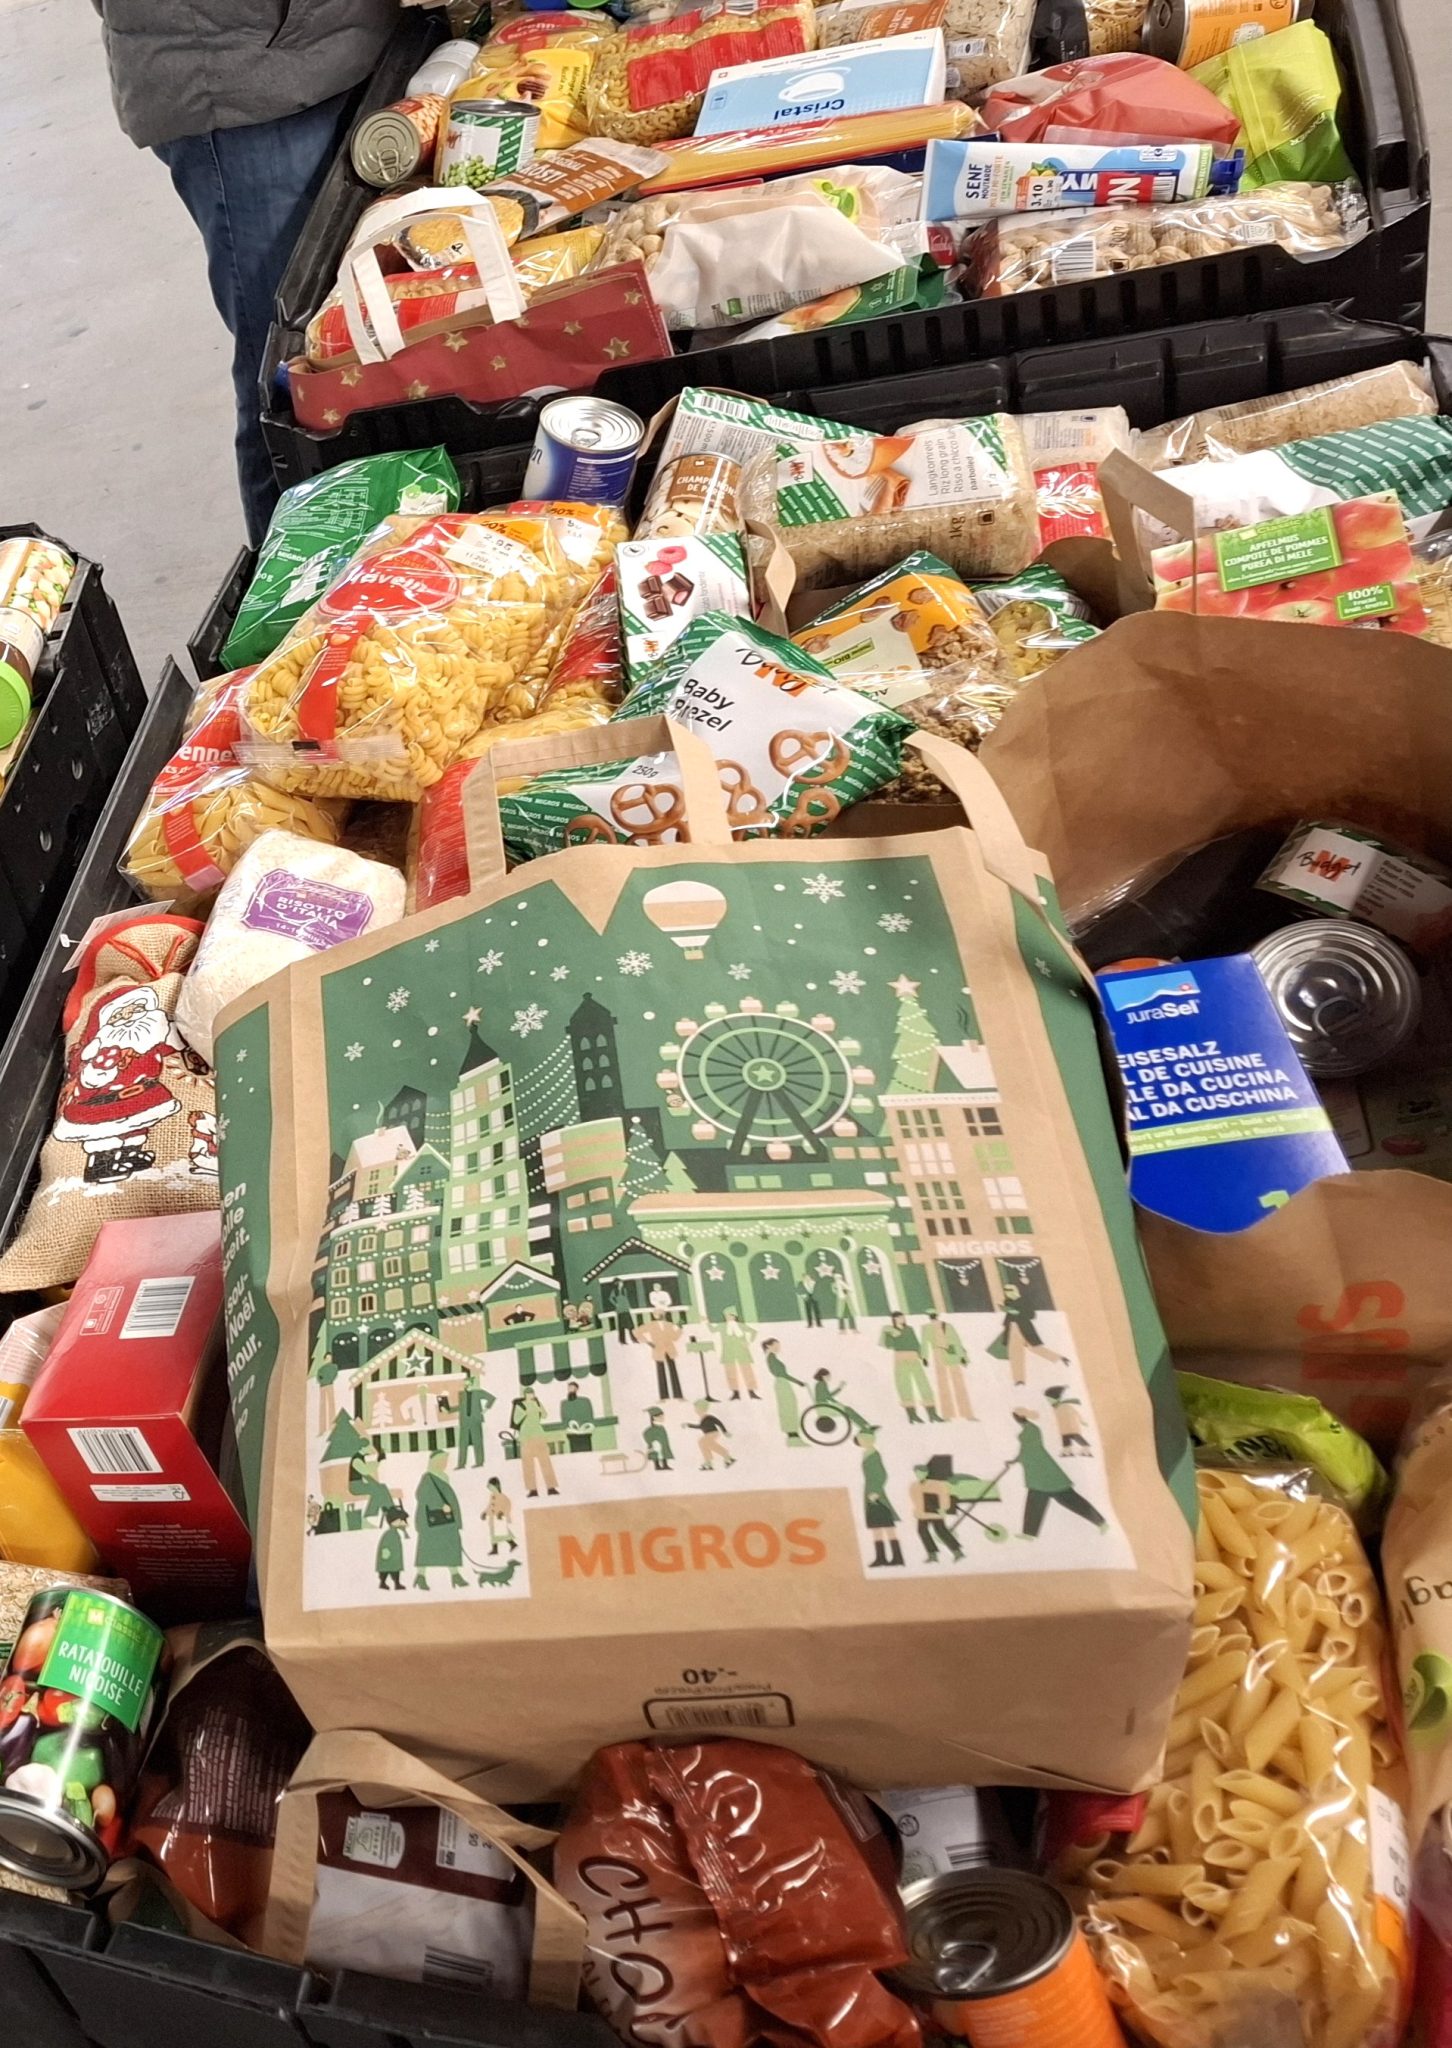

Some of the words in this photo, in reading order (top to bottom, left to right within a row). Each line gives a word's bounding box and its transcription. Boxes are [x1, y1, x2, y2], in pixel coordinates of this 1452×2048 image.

[773, 98, 846, 121] Cristal
[965, 163, 984, 199] SENF
[982, 164, 992, 199] MOUTARDE
[937, 439, 949, 458] grain
[924, 440, 939, 496] Langkornreis
[940, 460, 950, 482] long
[966, 456, 978, 491] parboiled
[687, 483, 699, 492] DE
[941, 484, 951, 494] Riz
[953, 474, 963, 493] Riso
[949, 516, 966, 539] 1kg
[1224, 550, 1270, 568] COMPOTE
[1271, 546, 1283, 557] DE
[1285, 536, 1329, 553] POMMES
[1249, 533, 1300, 553] APFELMUS
[1241, 558, 1274, 572] PUREA
[1275, 554, 1286, 565] DI
[1287, 549, 1313, 562] MELE
[1347, 586, 1383, 601] 100%
[685, 679, 734, 710] Baby
[179, 745, 233, 762] enne
[276, 902, 338, 930] D'ITALIA
[277, 896, 347, 920] RISOTTO
[1140, 1066, 1171, 1082] DE
[1174, 1052, 1267, 1078] CUISINE
[1162, 1082, 1197, 1098] DA
[1200, 1068, 1290, 1092] CUCINA
[1151, 1102, 1184, 1118] DA
[1185, 1086, 1299, 1113] CUSCHINA
[935, 1240, 1033, 1255] MIGROS
[558, 1517, 828, 1579] MIGROS
[58, 1641, 143, 1697] RATATOUILLE
